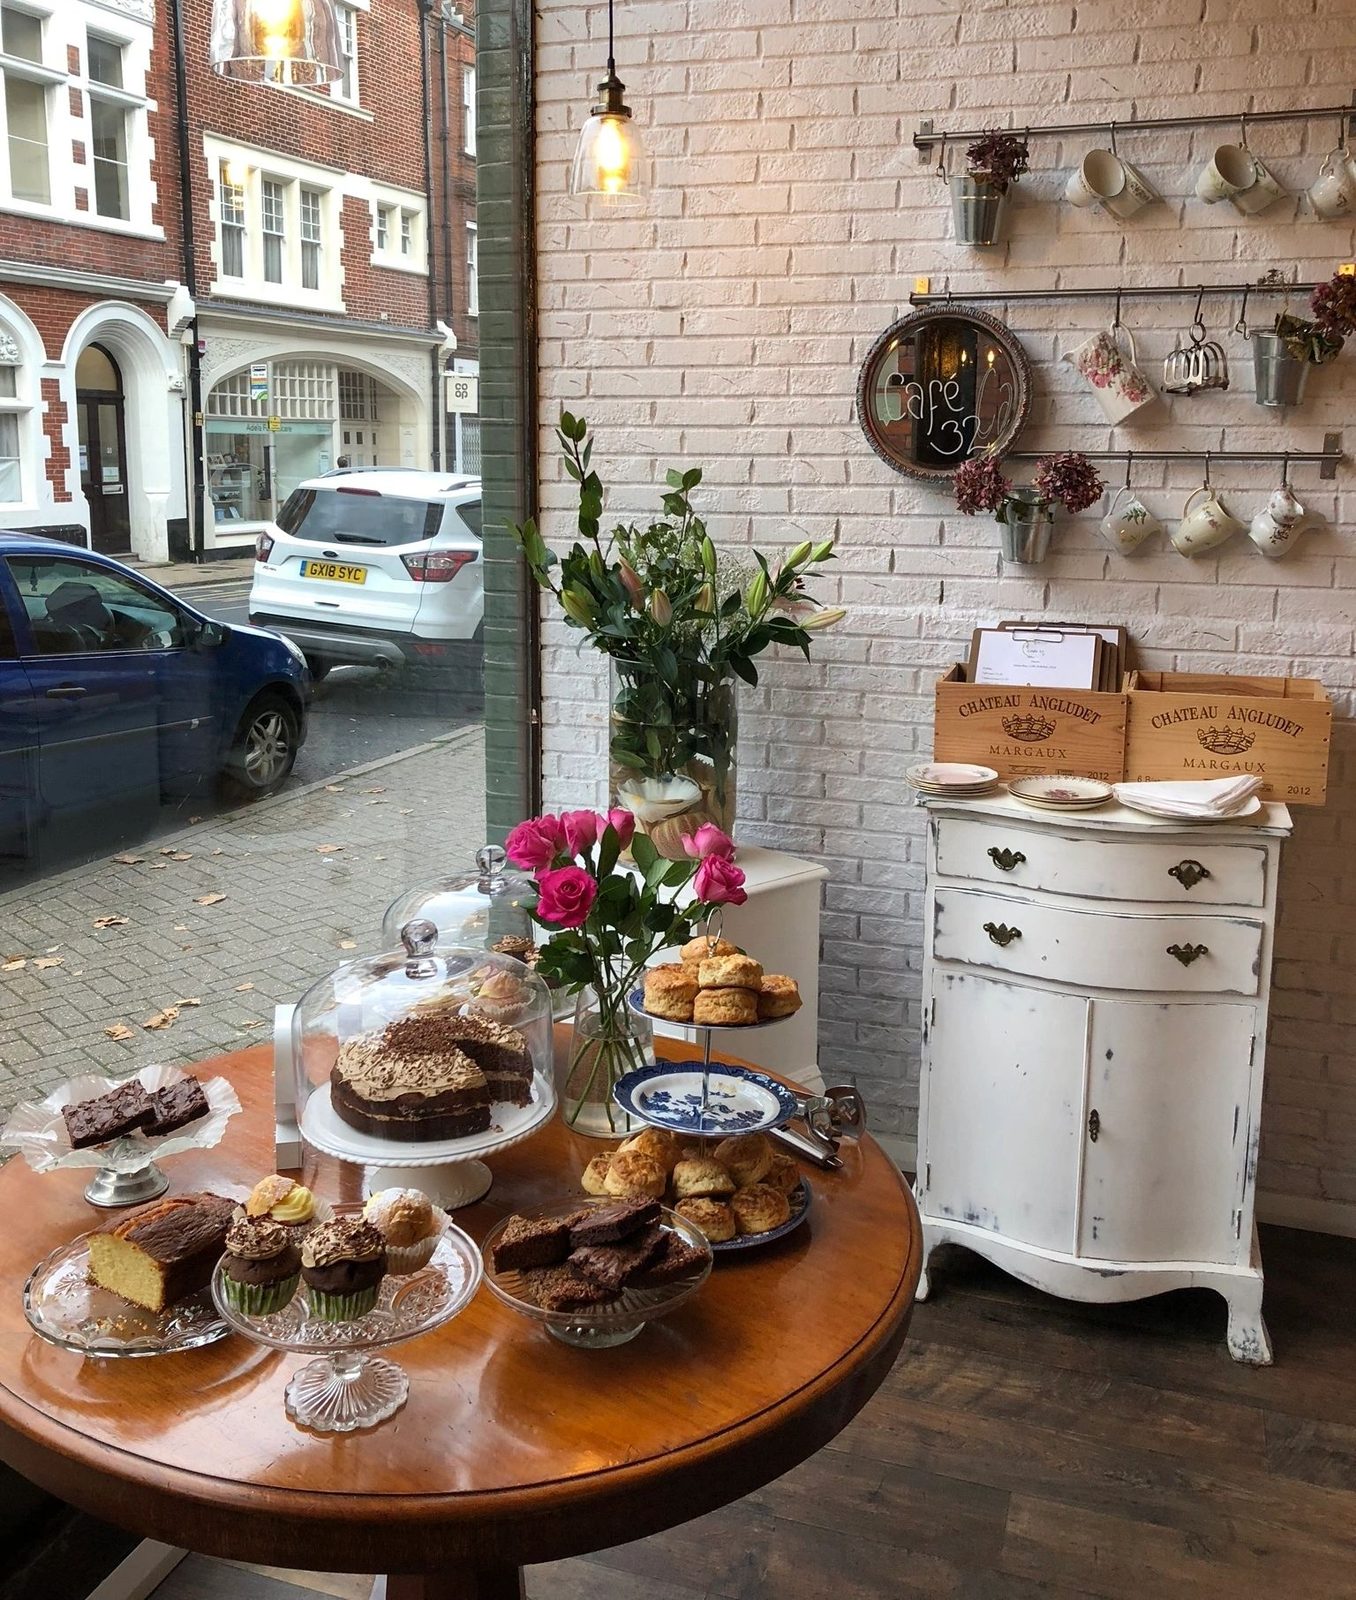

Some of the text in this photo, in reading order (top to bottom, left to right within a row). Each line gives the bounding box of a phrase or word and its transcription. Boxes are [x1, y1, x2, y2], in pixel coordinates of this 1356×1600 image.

[885, 372, 964, 435] Café
[930, 416, 991, 455] 32
[310, 563, 362, 580] GX18 SYC
[959, 694, 1102, 725] CHATEAU ANGLUDET
[1151, 705, 1304, 738] CHATEAU ANGLUDET
[989, 745, 1067, 758] MARGAUX
[1183, 758, 1266, 773] MARGAUX
[1087, 771, 1109, 780] 2012
[1287, 785, 1311, 795] 2012
